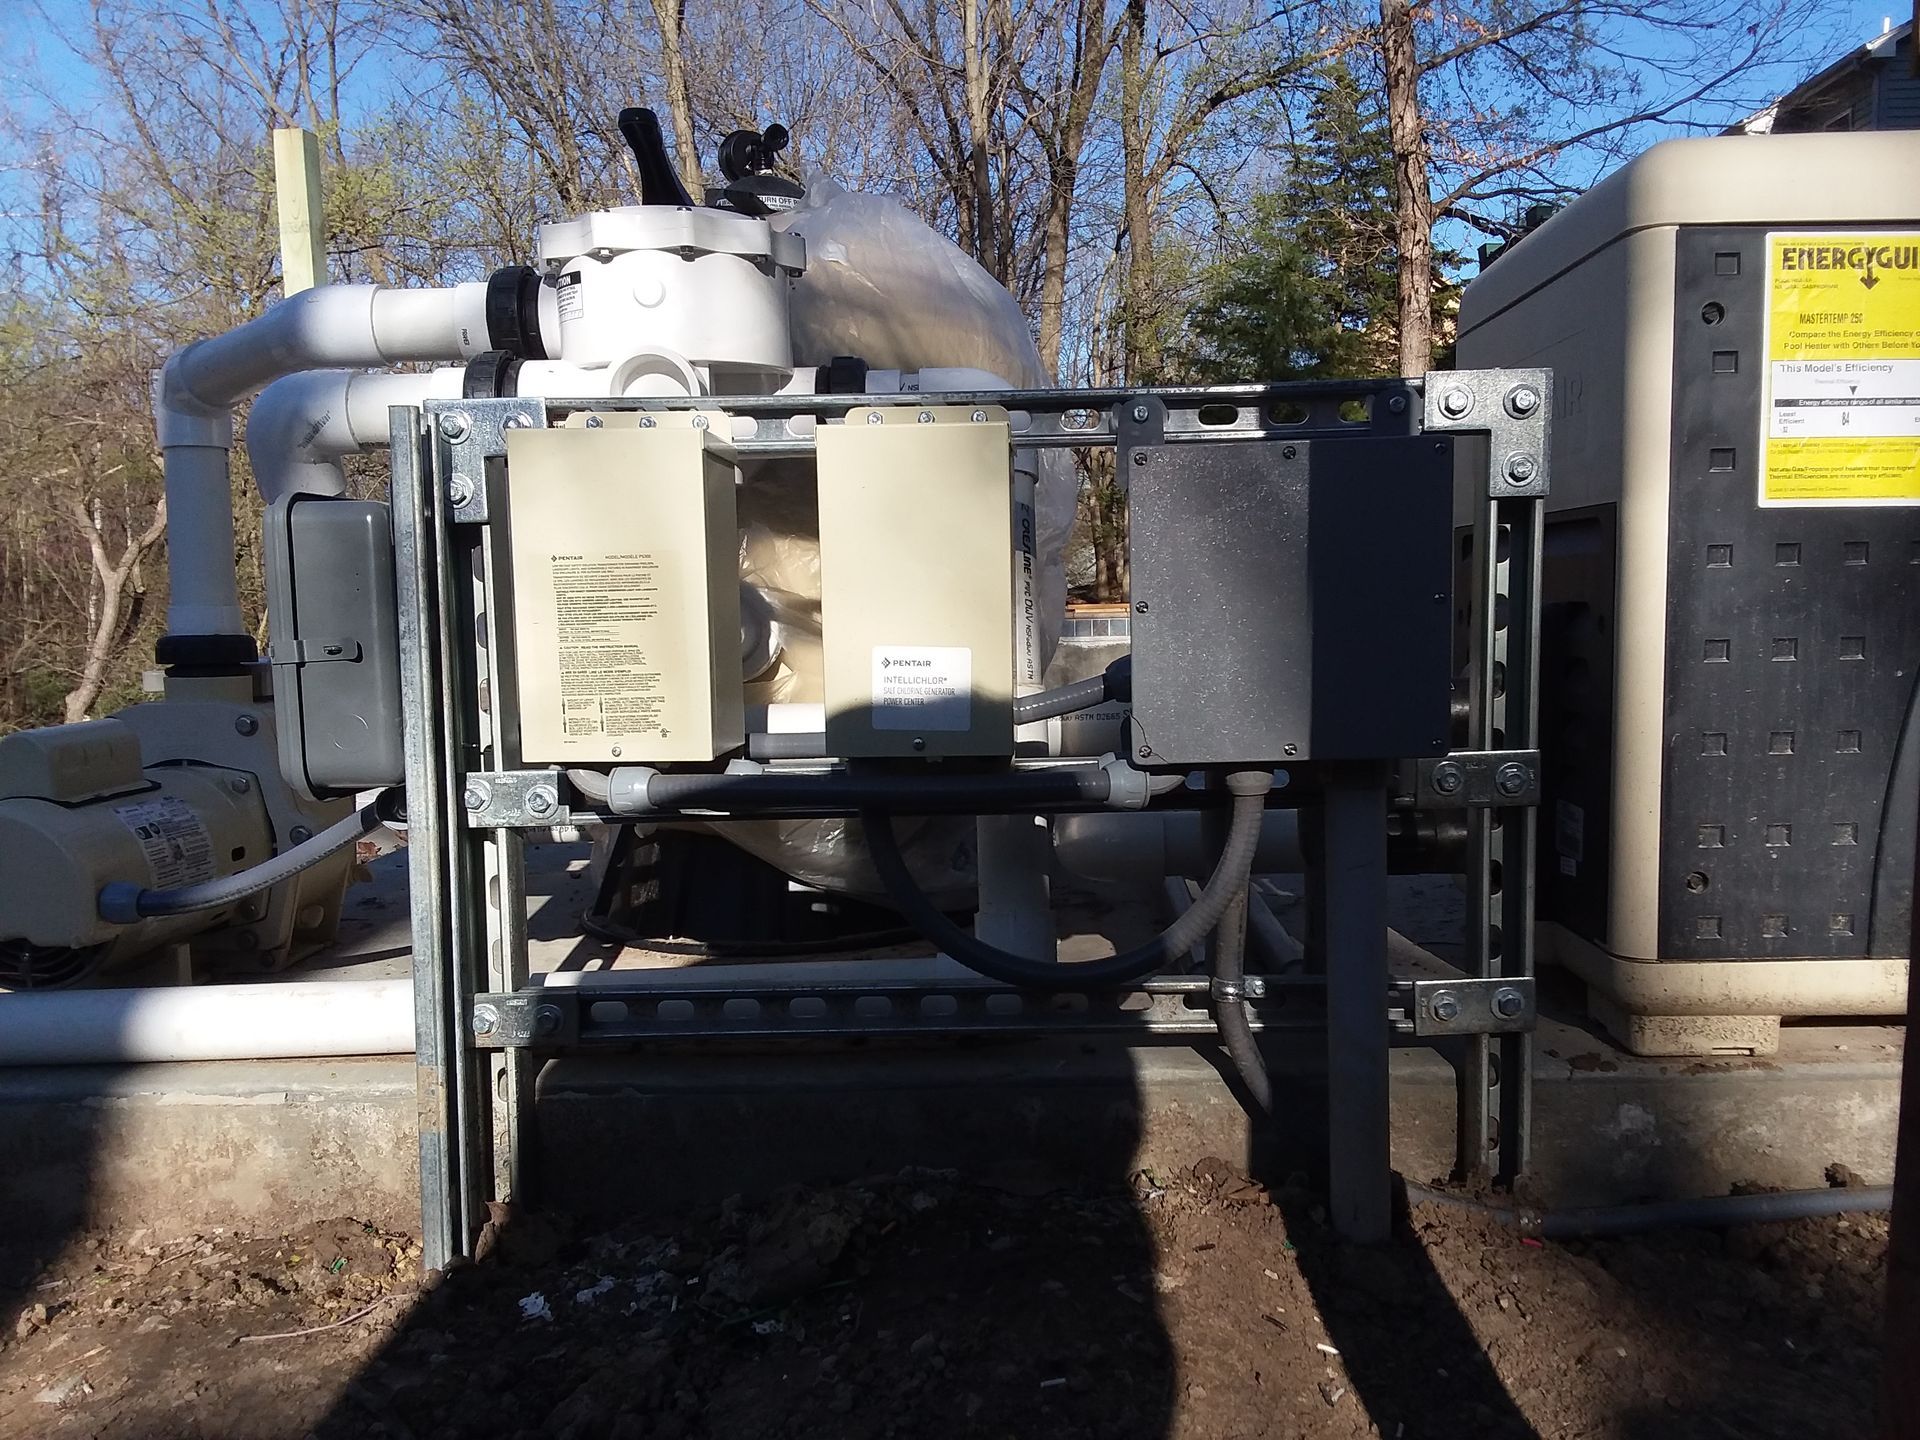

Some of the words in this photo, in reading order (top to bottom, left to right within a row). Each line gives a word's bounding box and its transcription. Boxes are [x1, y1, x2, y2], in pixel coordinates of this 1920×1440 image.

[1799, 312, 1848, 325] MASTERTEMP
[1789, 331, 1826, 339] Compare
[1828, 330, 1841, 338] the
[1843, 330, 1872, 339] Energy
[1874, 330, 1914, 338] Efficiency
[1783, 342, 1802, 350] Pool
[1804, 342, 1831, 350] Heater
[1853, 341, 1880, 349] Others
[1881, 341, 1909, 349] Before
[1780, 364, 1802, 373] This
[1804, 364, 1842, 373] Model's
[1845, 363, 1894, 374] Efficiency
[892, 659, 932, 667] PENTAIR
[924, 687, 956, 696] GENERATOR
[883, 697, 903, 706] POWER
[1074, 713, 1094, 721] ASTM
